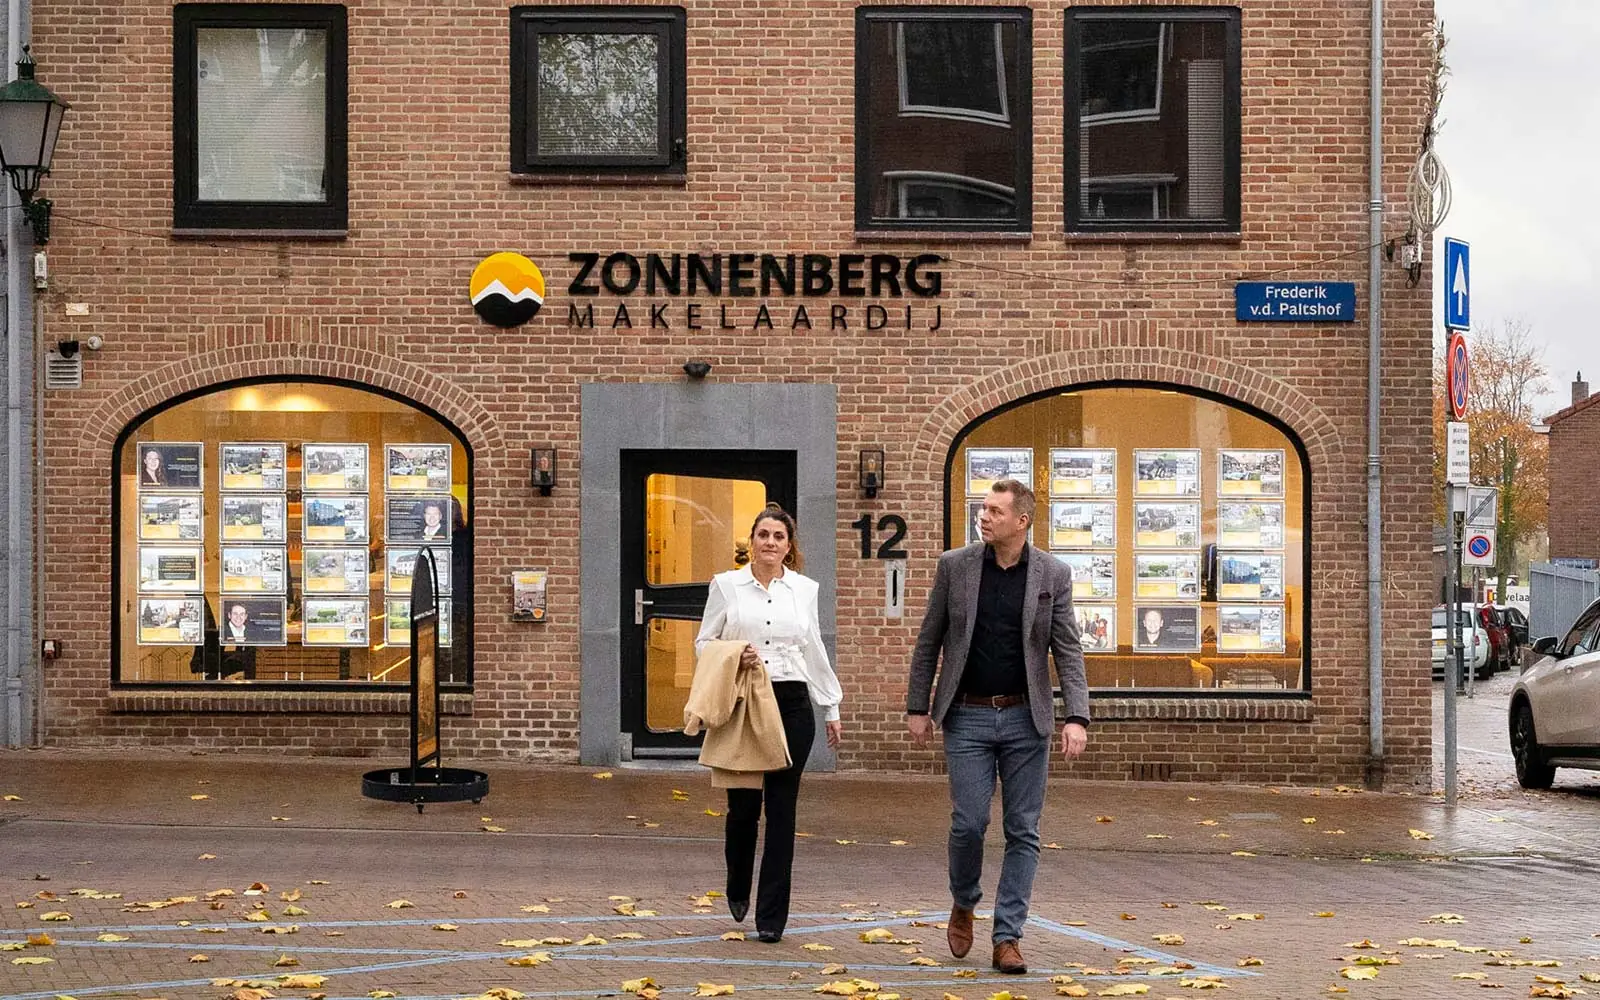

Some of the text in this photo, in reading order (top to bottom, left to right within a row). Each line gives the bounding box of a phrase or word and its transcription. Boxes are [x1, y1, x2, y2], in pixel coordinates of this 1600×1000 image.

[568, 252, 943, 297] ZONNENBERG
[1265, 286, 1327, 299] Frederik
[568, 303, 943, 331] MAKELAARDIJ
[1250, 303, 1342, 316] v.d. Paltshof
[851, 514, 908, 560] 12
